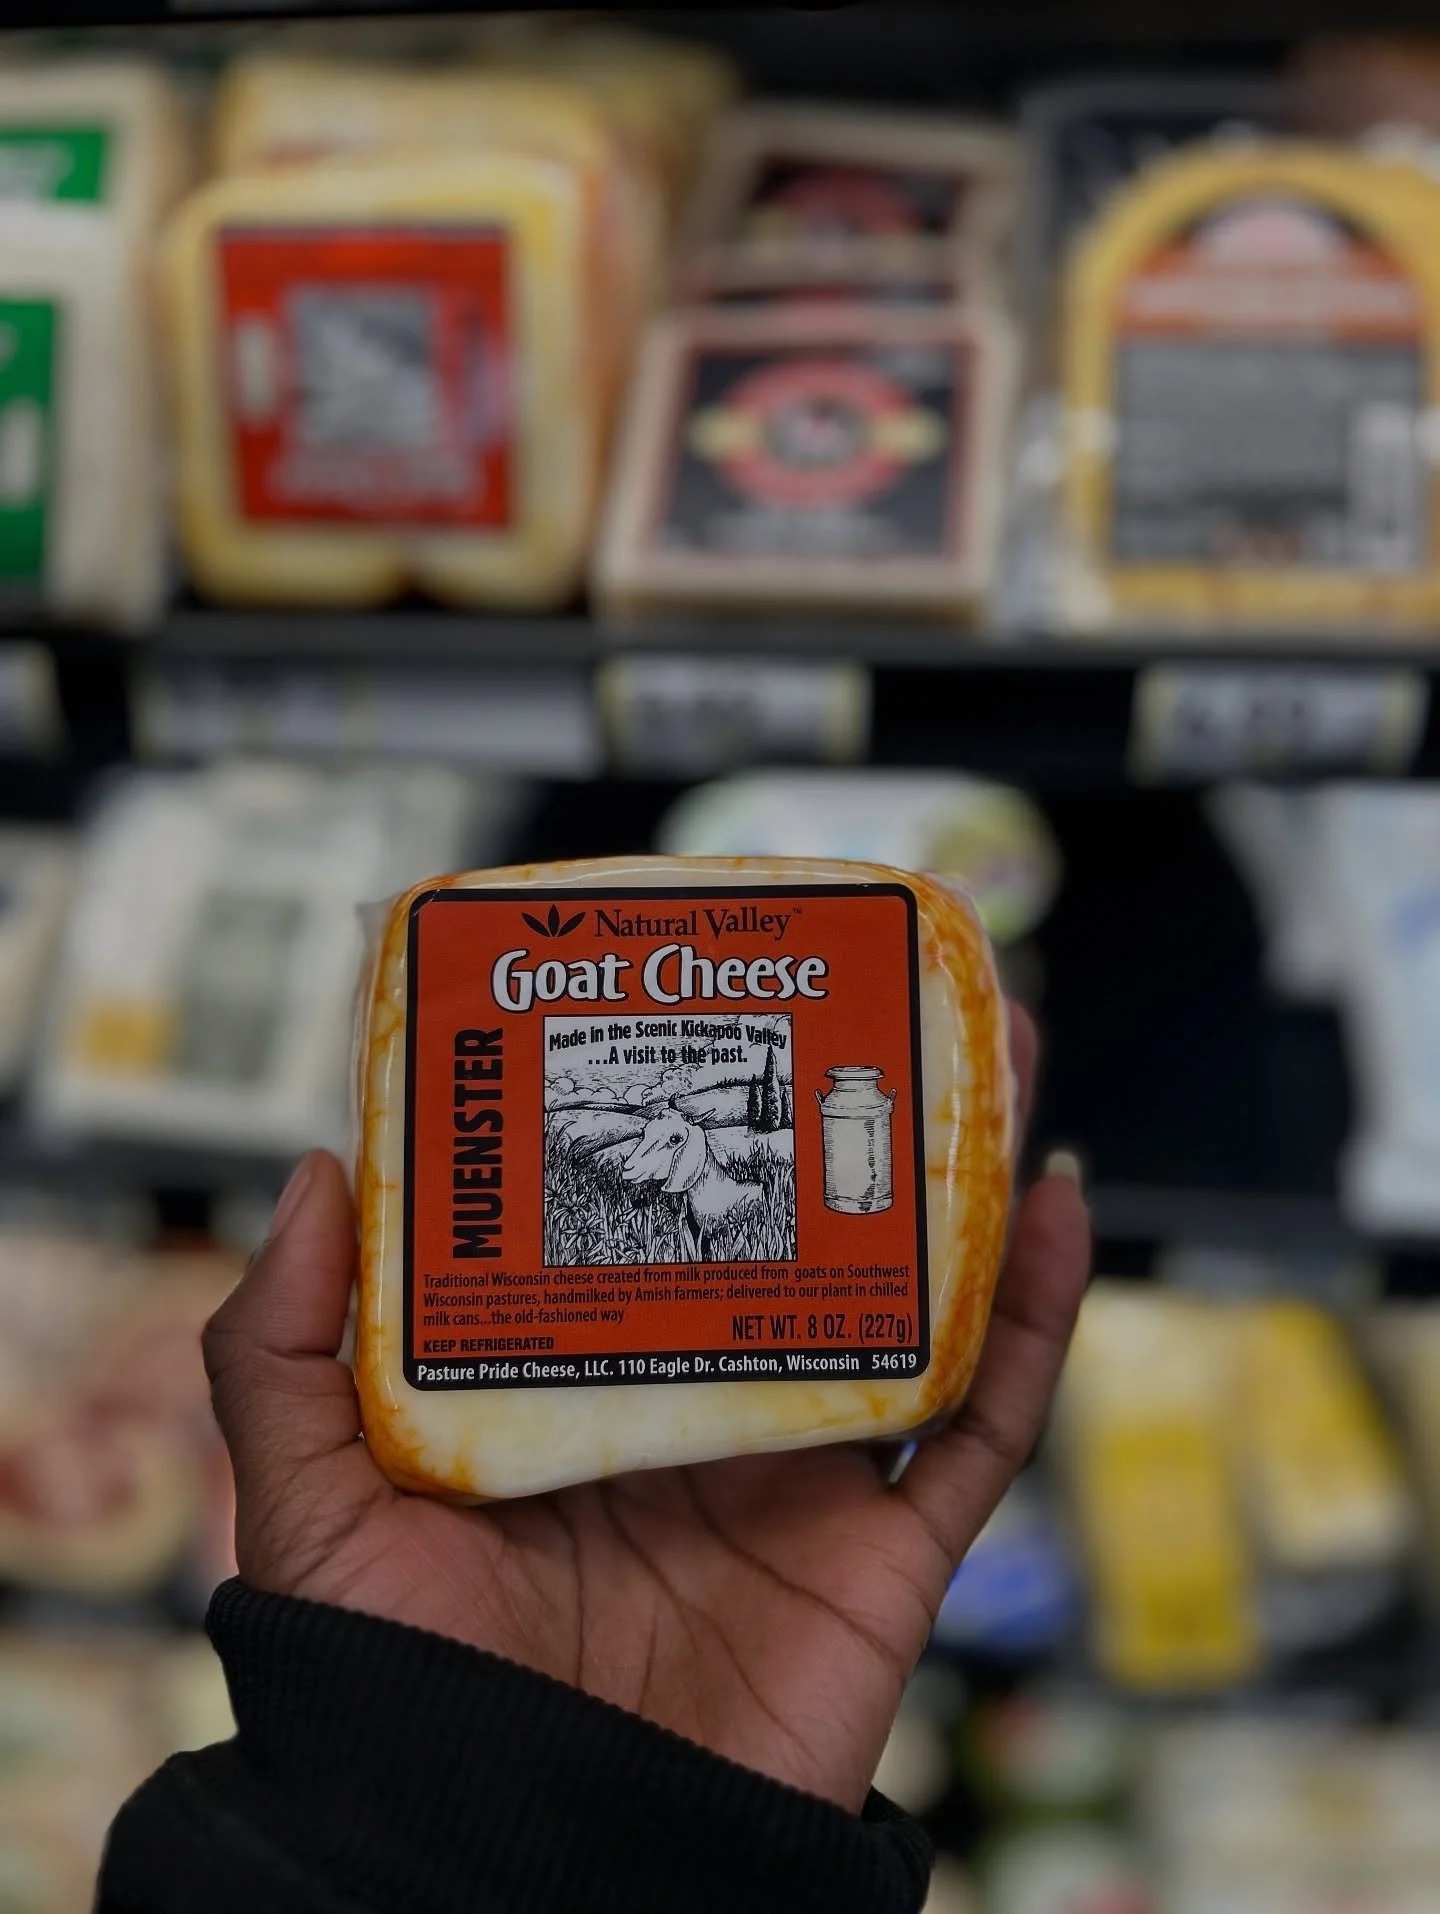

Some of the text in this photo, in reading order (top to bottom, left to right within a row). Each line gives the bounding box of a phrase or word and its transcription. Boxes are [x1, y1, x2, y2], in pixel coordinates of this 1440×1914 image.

[594, 909, 699, 937] Natural
[490, 942, 829, 1014] Goat Cheese
[549, 1020, 787, 1052] Made in the Scenic Kickapoo Valley
[624, 1047, 656, 1064] visit
[660, 1048, 675, 1064] to
[681, 1046, 707, 1064] the
[711, 1046, 748, 1065] past.
[452, 1028, 503, 1259] MUENSTER
[423, 1263, 910, 1289] Traditional Wisconsin cheese created from milk produced from goats on Southwest
[423, 1282, 909, 1309] Wisconsin pastures, handmilked by Amish farmers; delivered to our plant in chilled
[423, 1311, 450, 1327] milk
[514, 1308, 598, 1324] old-fashioned
[600, 1308, 625, 1325] way
[732, 1312, 913, 1344] NET WT. 8 OZ. (227g)
[423, 1336, 555, 1353] KEEP REFRIGERATED
[417, 1353, 917, 1382] Pasture Pride Cheese, LLC. 110 Eagle Dr. Cashton, Wisconsin 54619
